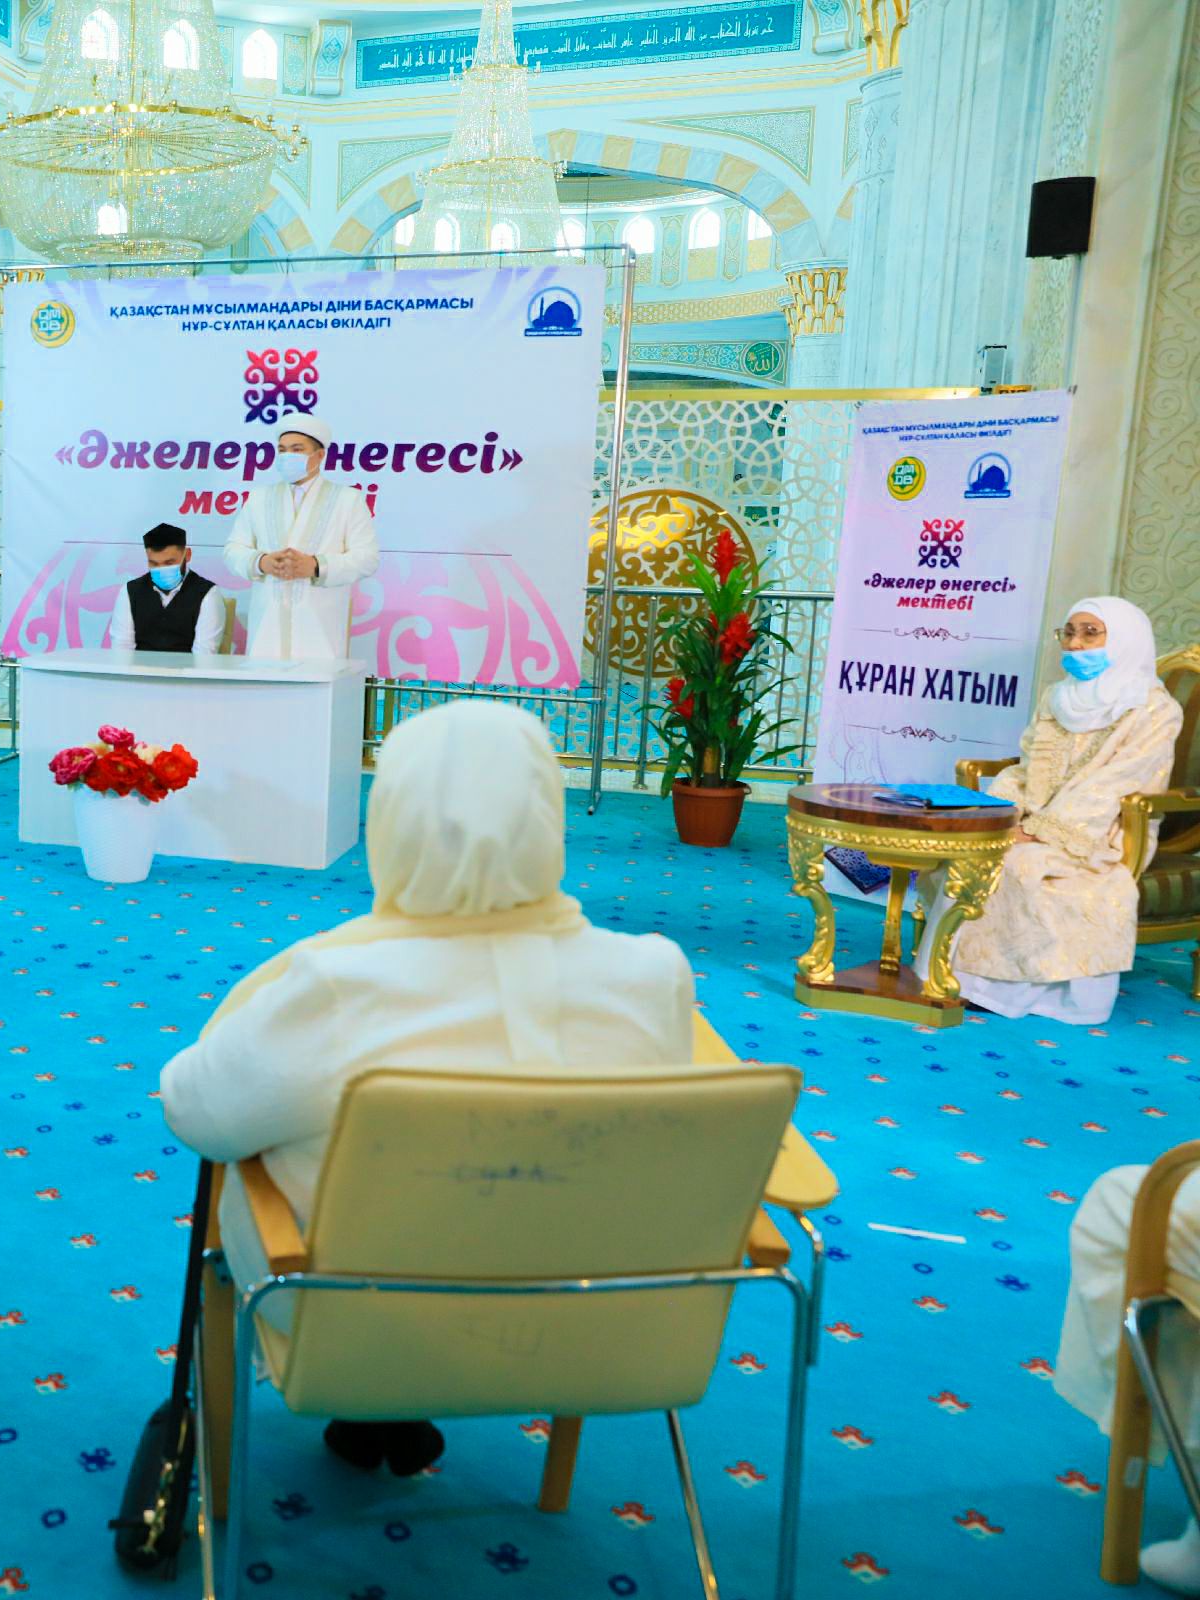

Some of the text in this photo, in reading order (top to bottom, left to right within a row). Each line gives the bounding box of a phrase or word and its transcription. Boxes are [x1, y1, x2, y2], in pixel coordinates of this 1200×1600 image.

[110, 298, 474, 318] ҚАЗАҚСТАН МҰСЫЛМАНДАРЫ ДІНИ БАСҚАРМАСЫ
[182, 317, 391, 332] НҰР-СҰЛТАН ҚАЛАСЫ ӨКІЛДІГІ
[53, 429, 523, 481] «Әжелер негесі»
[864, 573, 1017, 593] «Әжелер өнегесі»
[897, 594, 974, 610] мектебі
[839, 660, 1018, 708] ҚҰРАН ХАТЫМ
